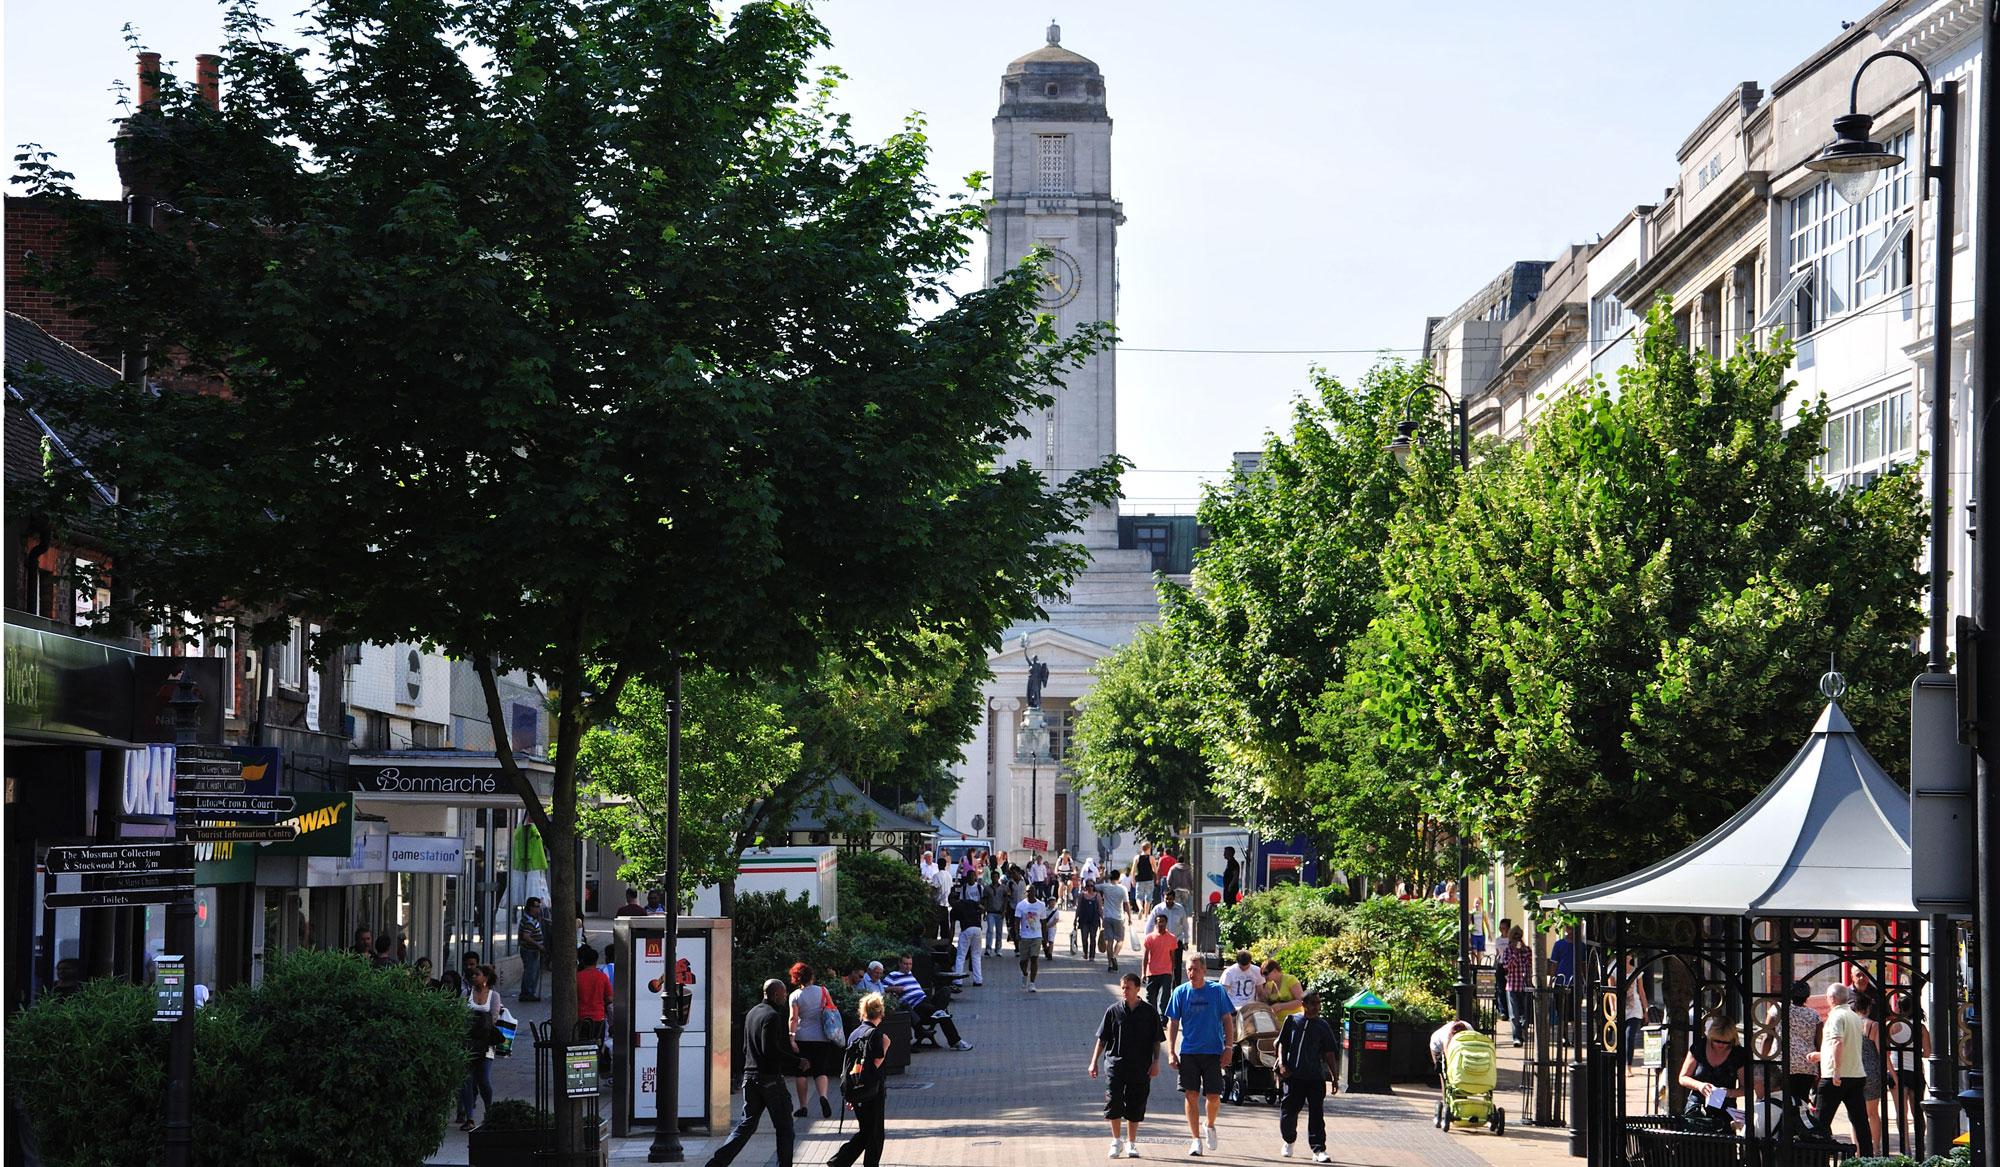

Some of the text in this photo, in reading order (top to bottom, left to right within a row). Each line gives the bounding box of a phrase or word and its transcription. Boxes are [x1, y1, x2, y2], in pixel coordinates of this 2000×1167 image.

[377, 767, 496, 792] Bonmarché
[222, 798, 247, 809] Crown
[251, 799, 274, 809] Court
[197, 828, 292, 839] Tourist Information Centre
[63, 848, 161, 859] The Mossman Collection
[392, 849, 455, 862] gamestation
[63, 862, 70, 870] &
[74, 861, 115, 870] Stockwood
[119, 860, 137, 869] Park
[102, 895, 129, 904] Toilets
[1236, 980, 1253, 997] 10
